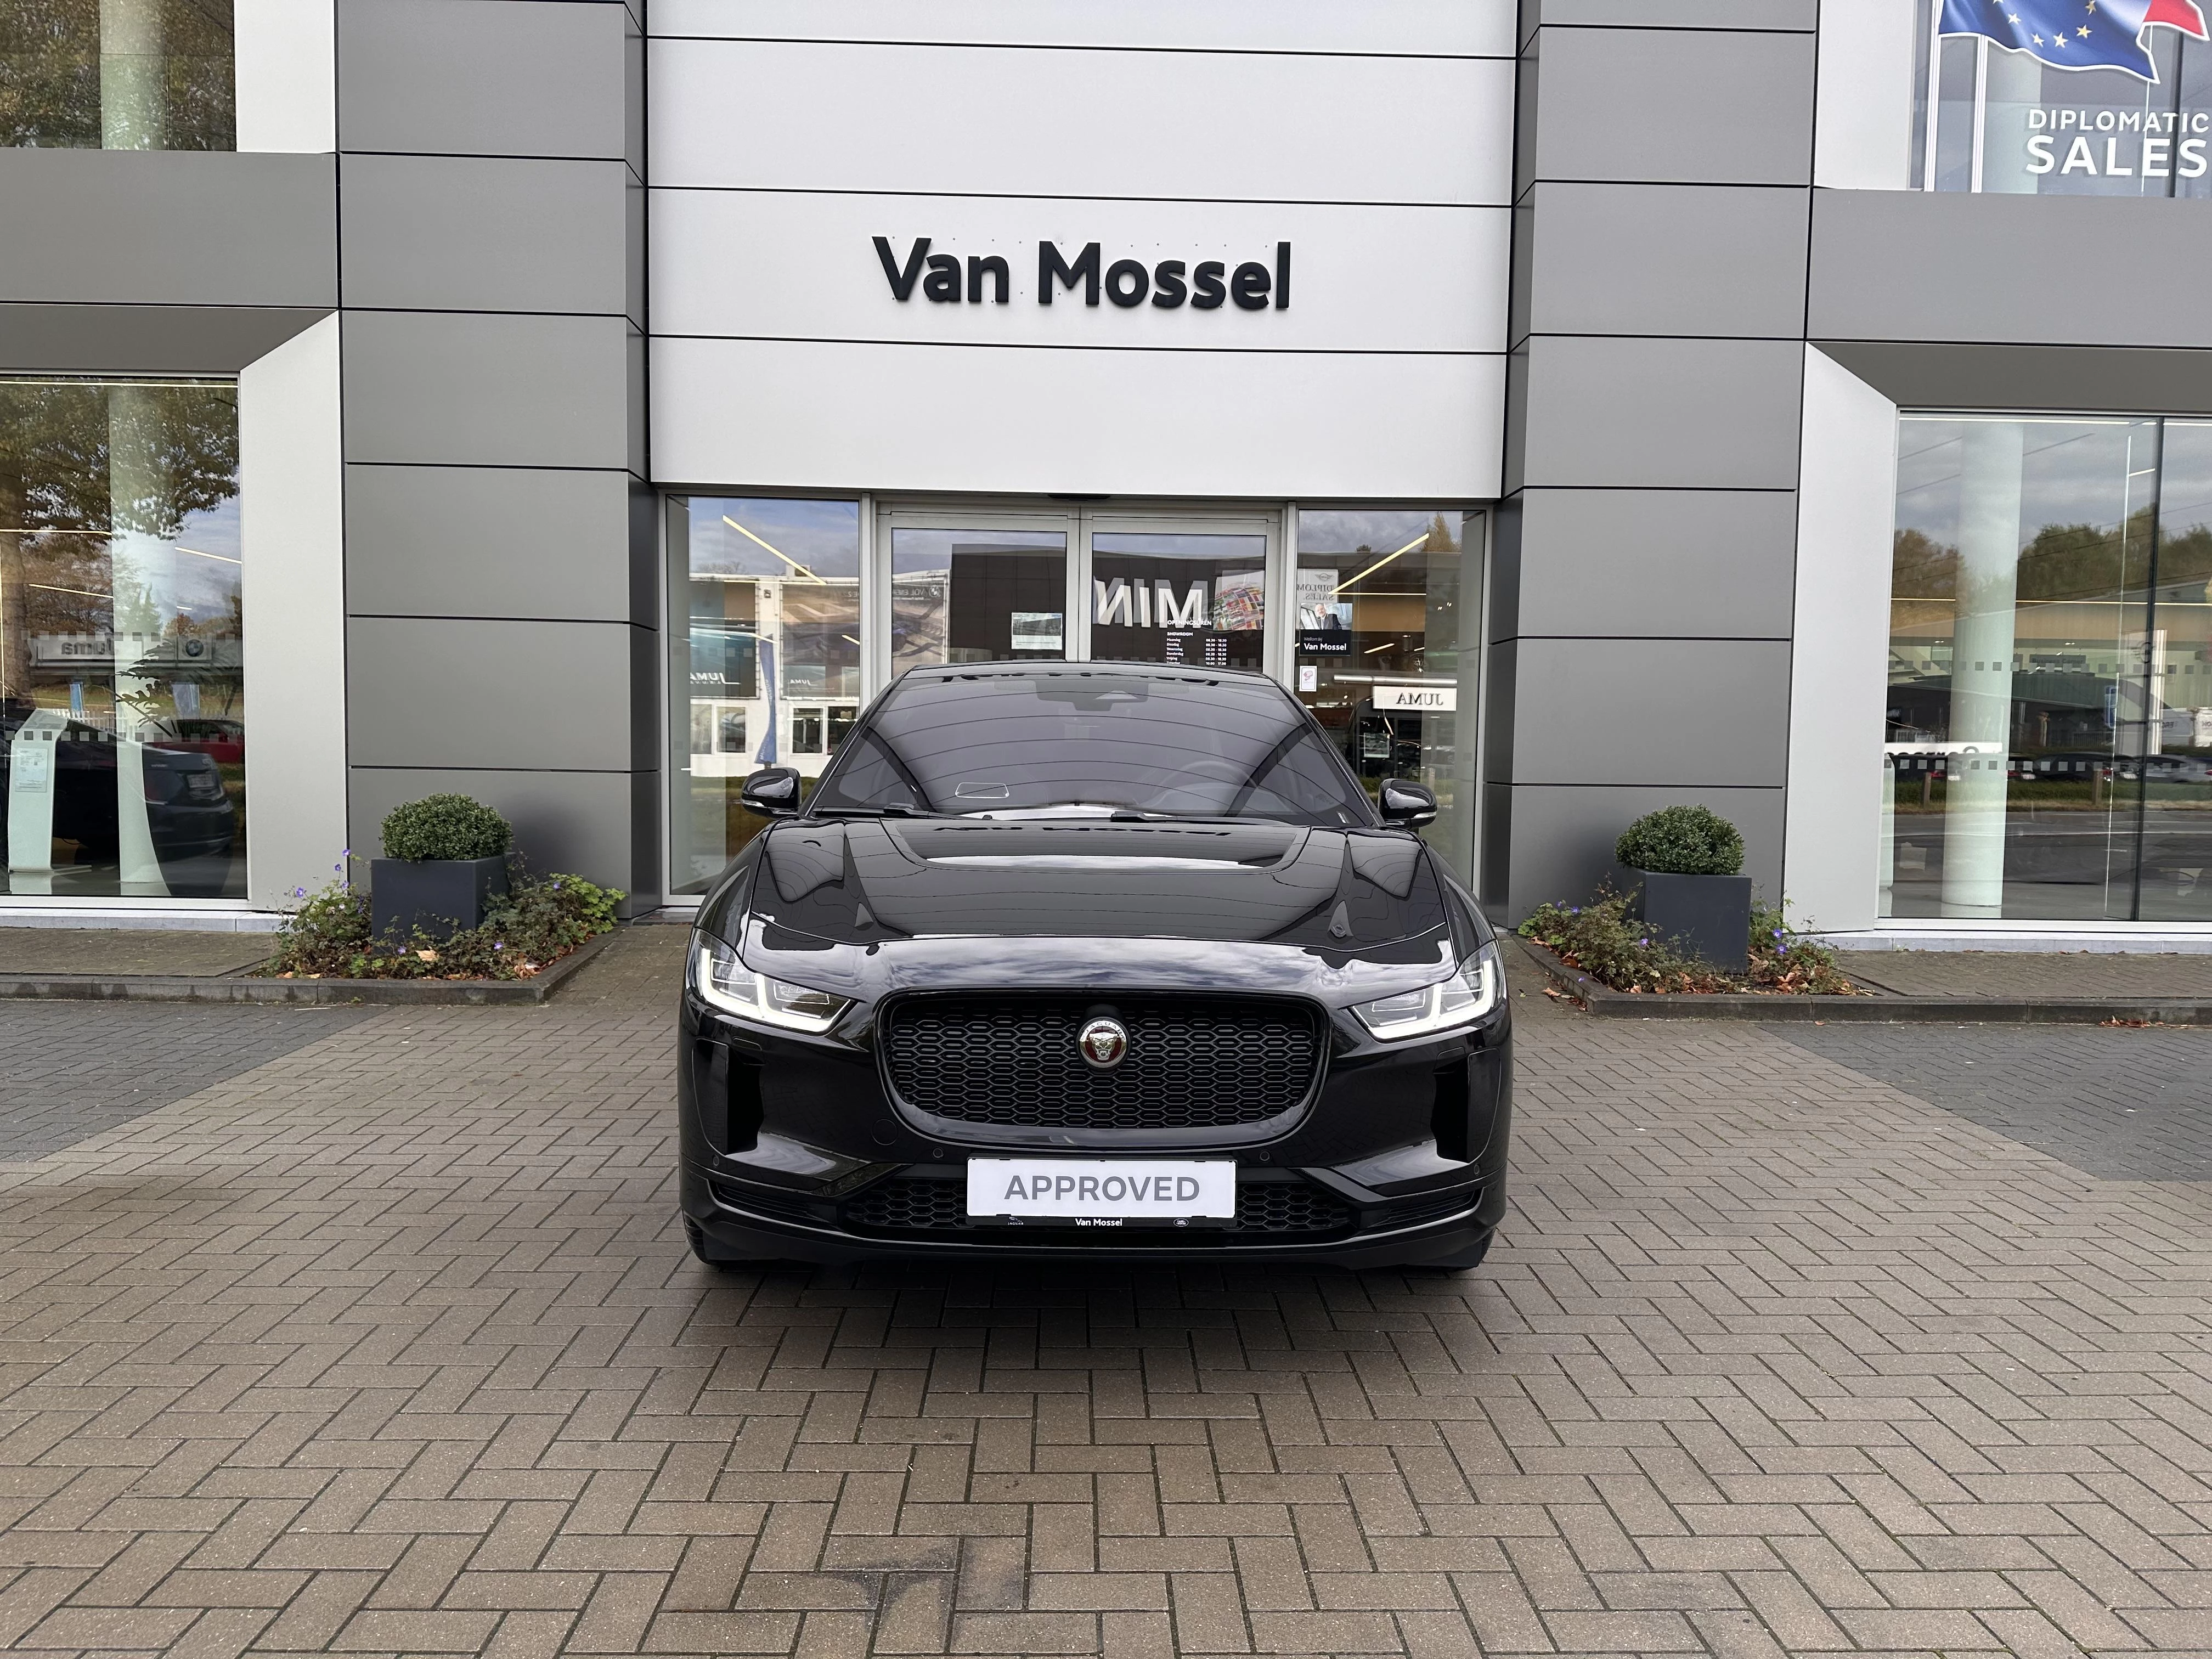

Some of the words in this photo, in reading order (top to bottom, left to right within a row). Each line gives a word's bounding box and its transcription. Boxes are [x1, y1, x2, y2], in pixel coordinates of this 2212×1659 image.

[2029, 109, 2209, 133] DIPLOMATIC
[2025, 135, 2208, 178] SALES
[872, 236, 1009, 302] Van
[1038, 241, 1291, 308] Mossel
[1004, 1175, 1200, 1201] APPROVED
[1075, 1218, 1092, 1226] Van
[1093, 1218, 1123, 1227] Mossel
